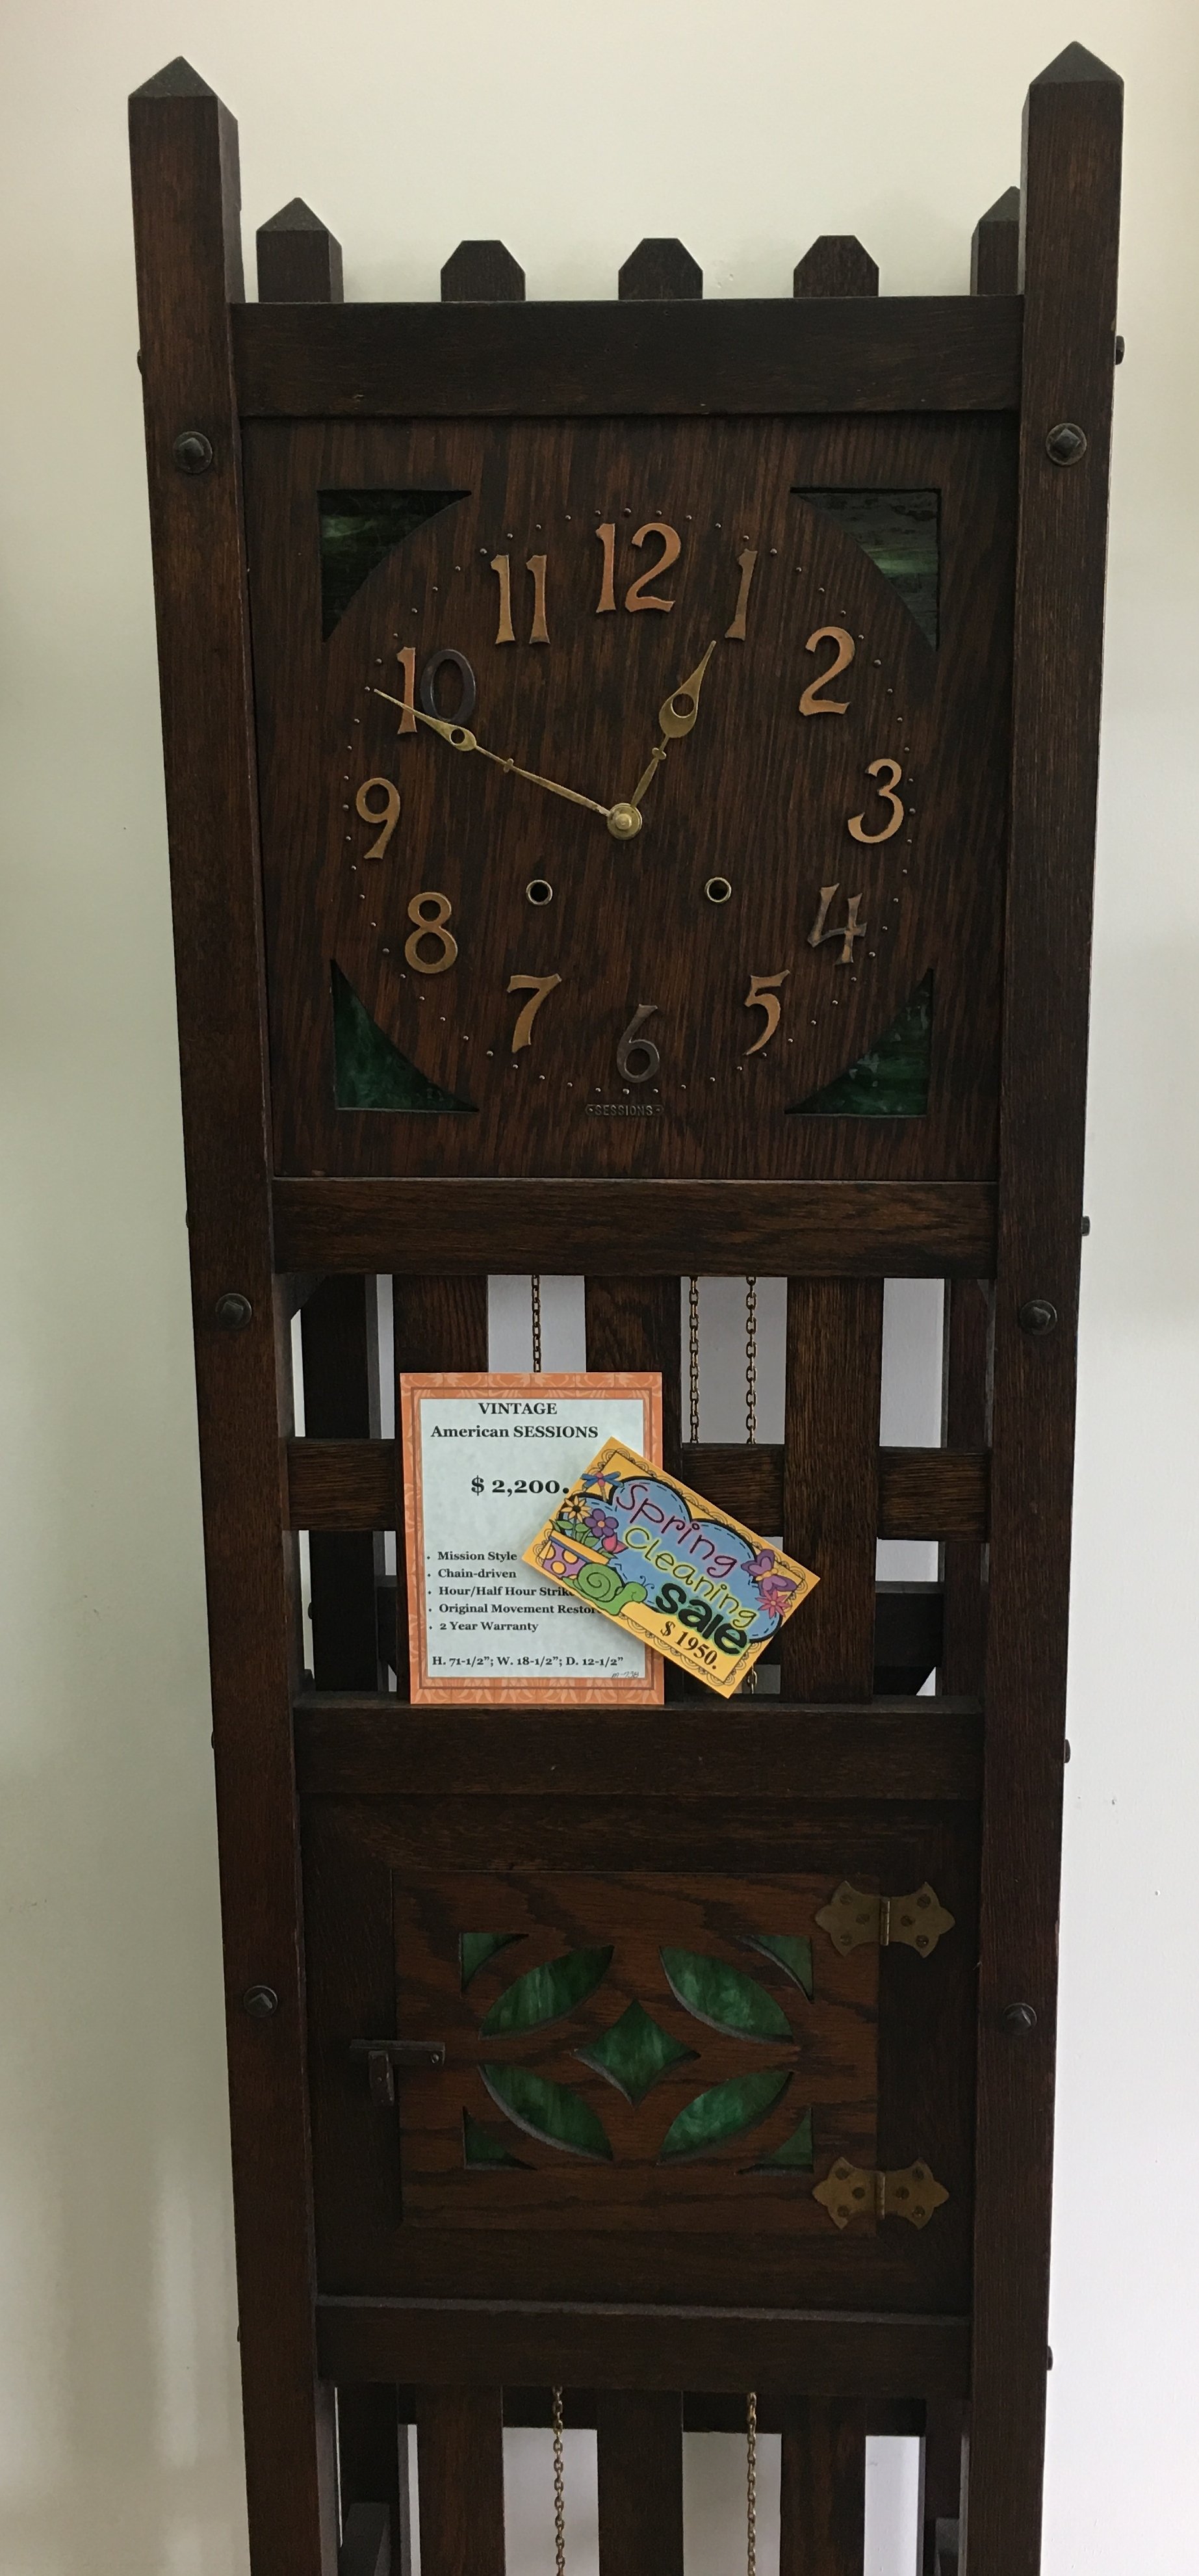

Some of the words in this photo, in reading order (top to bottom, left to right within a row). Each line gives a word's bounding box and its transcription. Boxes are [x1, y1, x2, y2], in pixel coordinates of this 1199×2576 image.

[490, 554, 550, 644] 11
[595, 523, 682, 613] 12
[725, 549, 757, 641] 1
[396, 647, 476, 734] 10
[798, 627, 856, 716] 2
[355, 777, 400, 859] 9
[847, 759, 905, 844] 3
[404, 892, 458, 974] 8
[806, 883, 868, 966] 4
[506, 973, 561, 1053] 7
[616, 1004, 660, 1083] 6
[743, 970, 790, 1057] 5
[595, 1105, 653, 1116] SESSIONS
[431, 1425, 509, 1438] American
[513, 1425, 599, 1438] SESSIONS
[478, 1403, 558, 1414] VINTAGE
[471, 1475, 484, 1496] $
[492, 1479, 569, 1497] 2,200.
[437, 1551, 485, 1560] Mission
[487, 1551, 517, 1562] Style
[616, 1484, 738, 1578] Spring
[438, 1568, 517, 1578] Chain-driven
[439, 1586, 503, 1597] Hour/Half
[505, 1587, 537, 1596] Hour
[439, 1604, 487, 1615] Original
[491, 1604, 554, 1613] Movement
[432, 1656, 446, 1665] H.
[496, 1656, 513, 1665] W.
[565, 1656, 578, 1665] D.
[450, 1621, 478, 1630] Year
[480, 1621, 539, 1632] Warranty
[660, 1620, 676, 1636] $
[675, 1631, 717, 1669] 1950.
